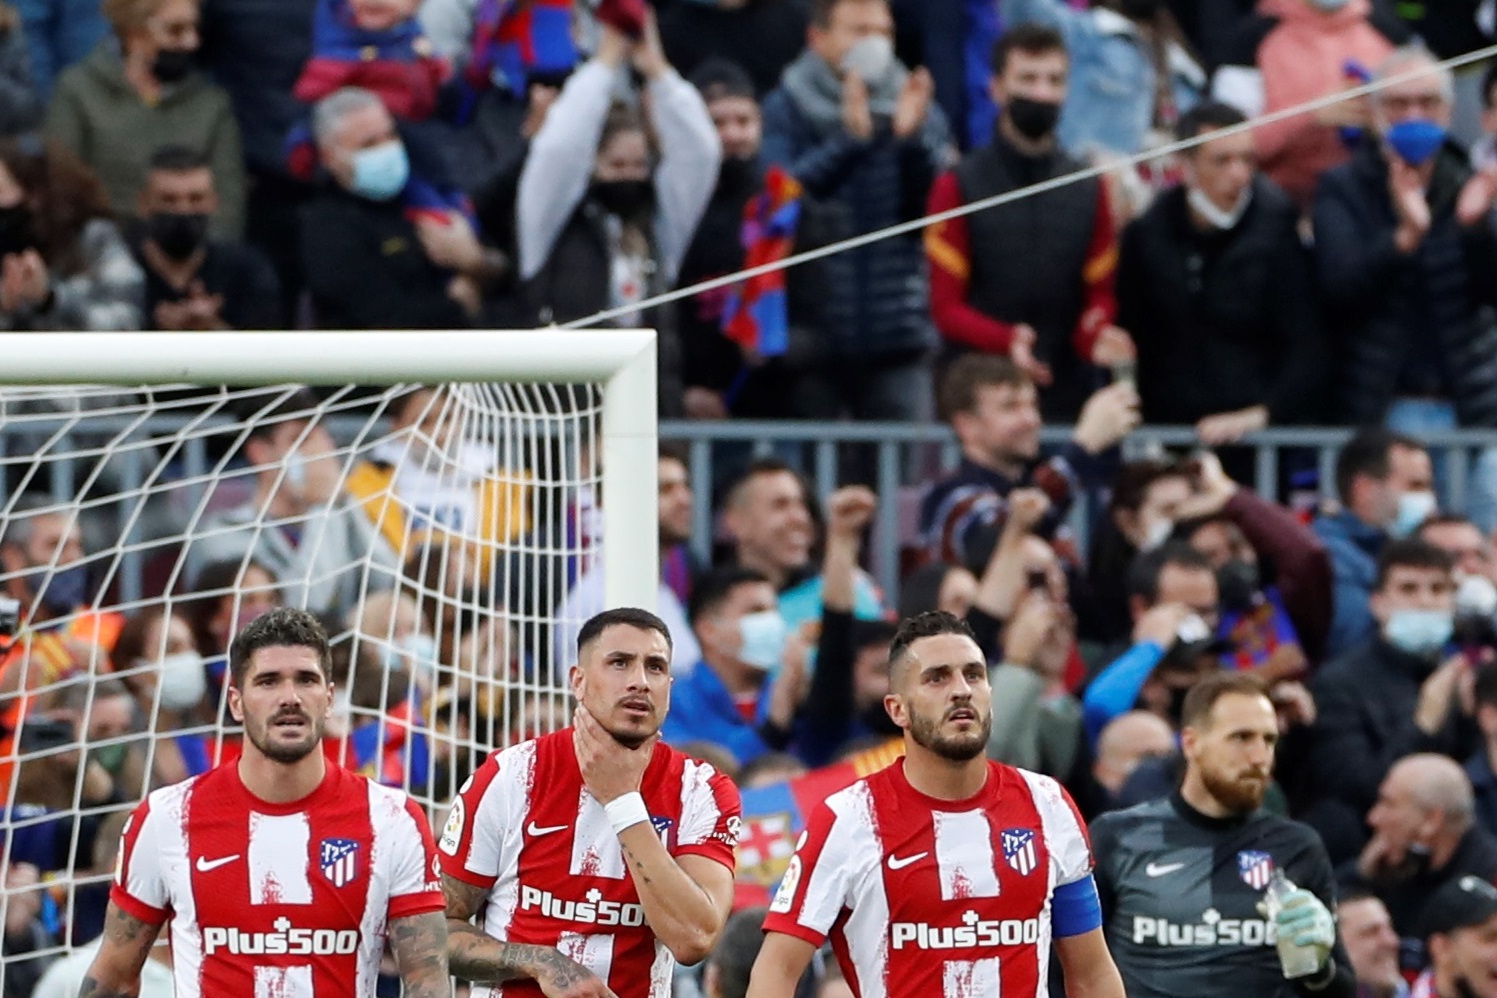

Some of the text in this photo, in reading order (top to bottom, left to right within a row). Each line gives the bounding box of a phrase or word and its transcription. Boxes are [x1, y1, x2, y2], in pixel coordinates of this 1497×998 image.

[521, 884, 650, 927] Plus50
[204, 917, 358, 955] Plus500
[892, 910, 1039, 949] Plus500
